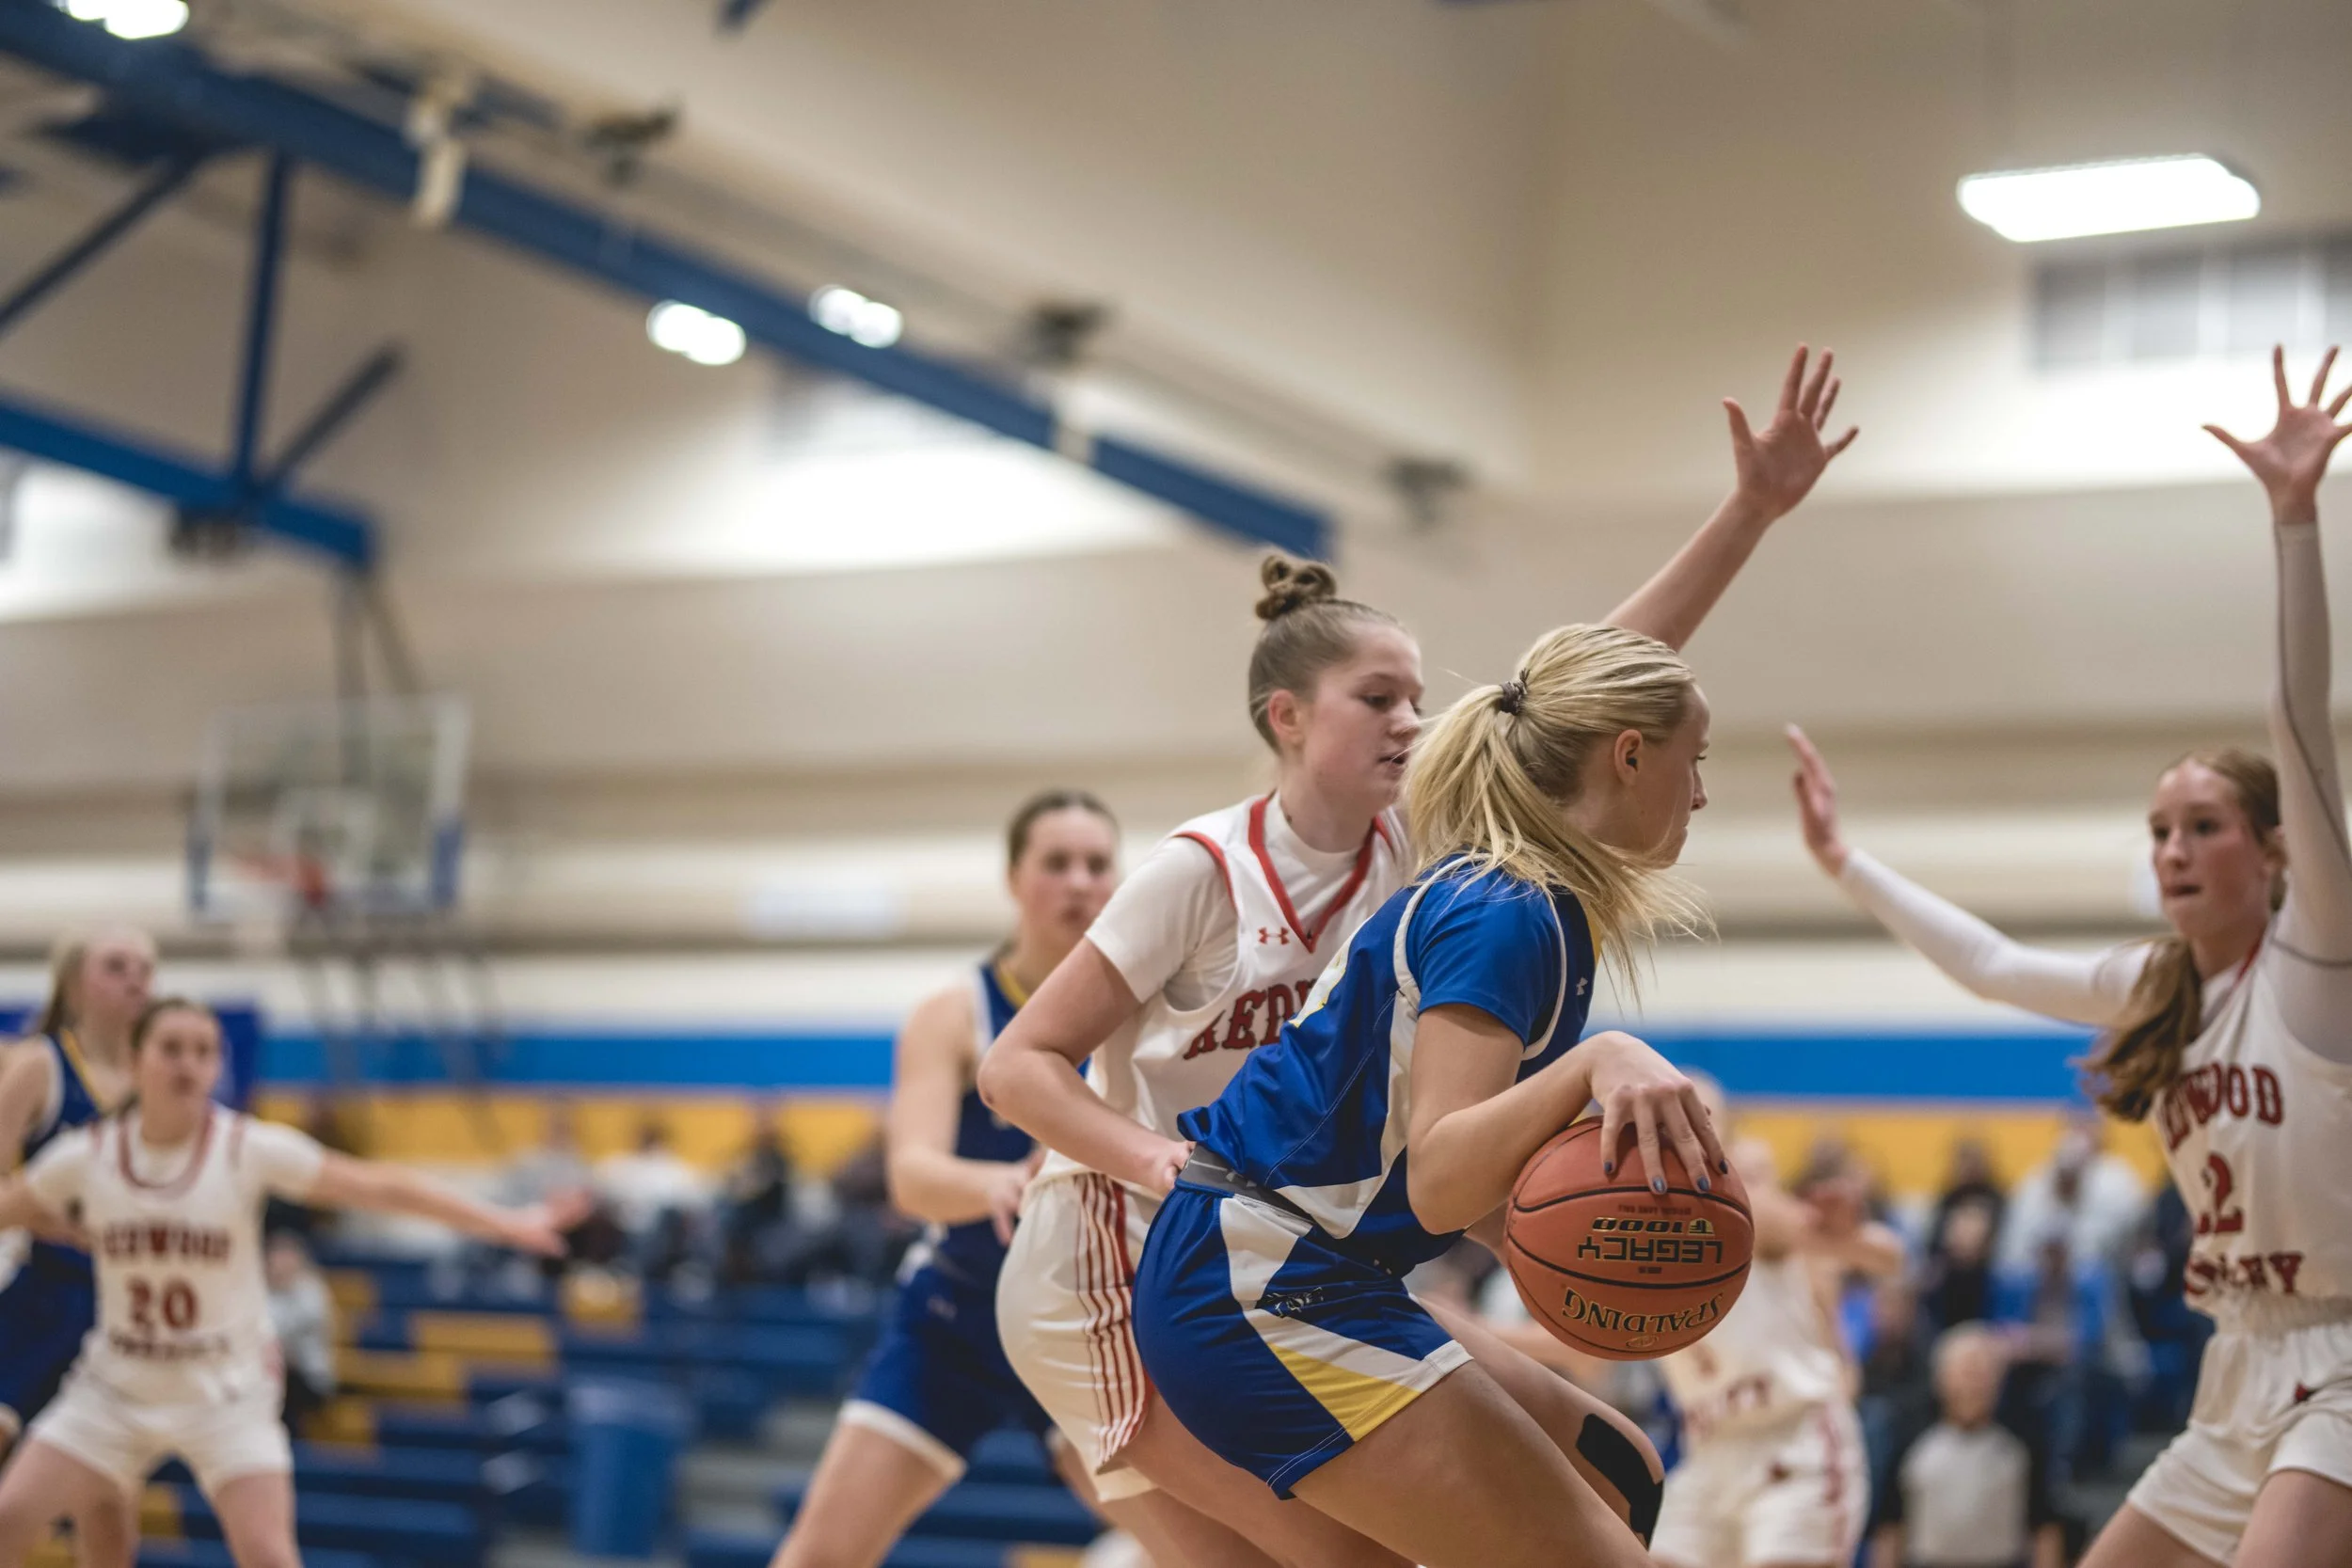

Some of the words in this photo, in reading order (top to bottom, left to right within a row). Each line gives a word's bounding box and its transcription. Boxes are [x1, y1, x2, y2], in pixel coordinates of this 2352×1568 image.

[1592, 1216, 1684, 1234] 1000
[1577, 1235, 1724, 1265] LEGACY
[1562, 1287, 1724, 1334] SPALDING
